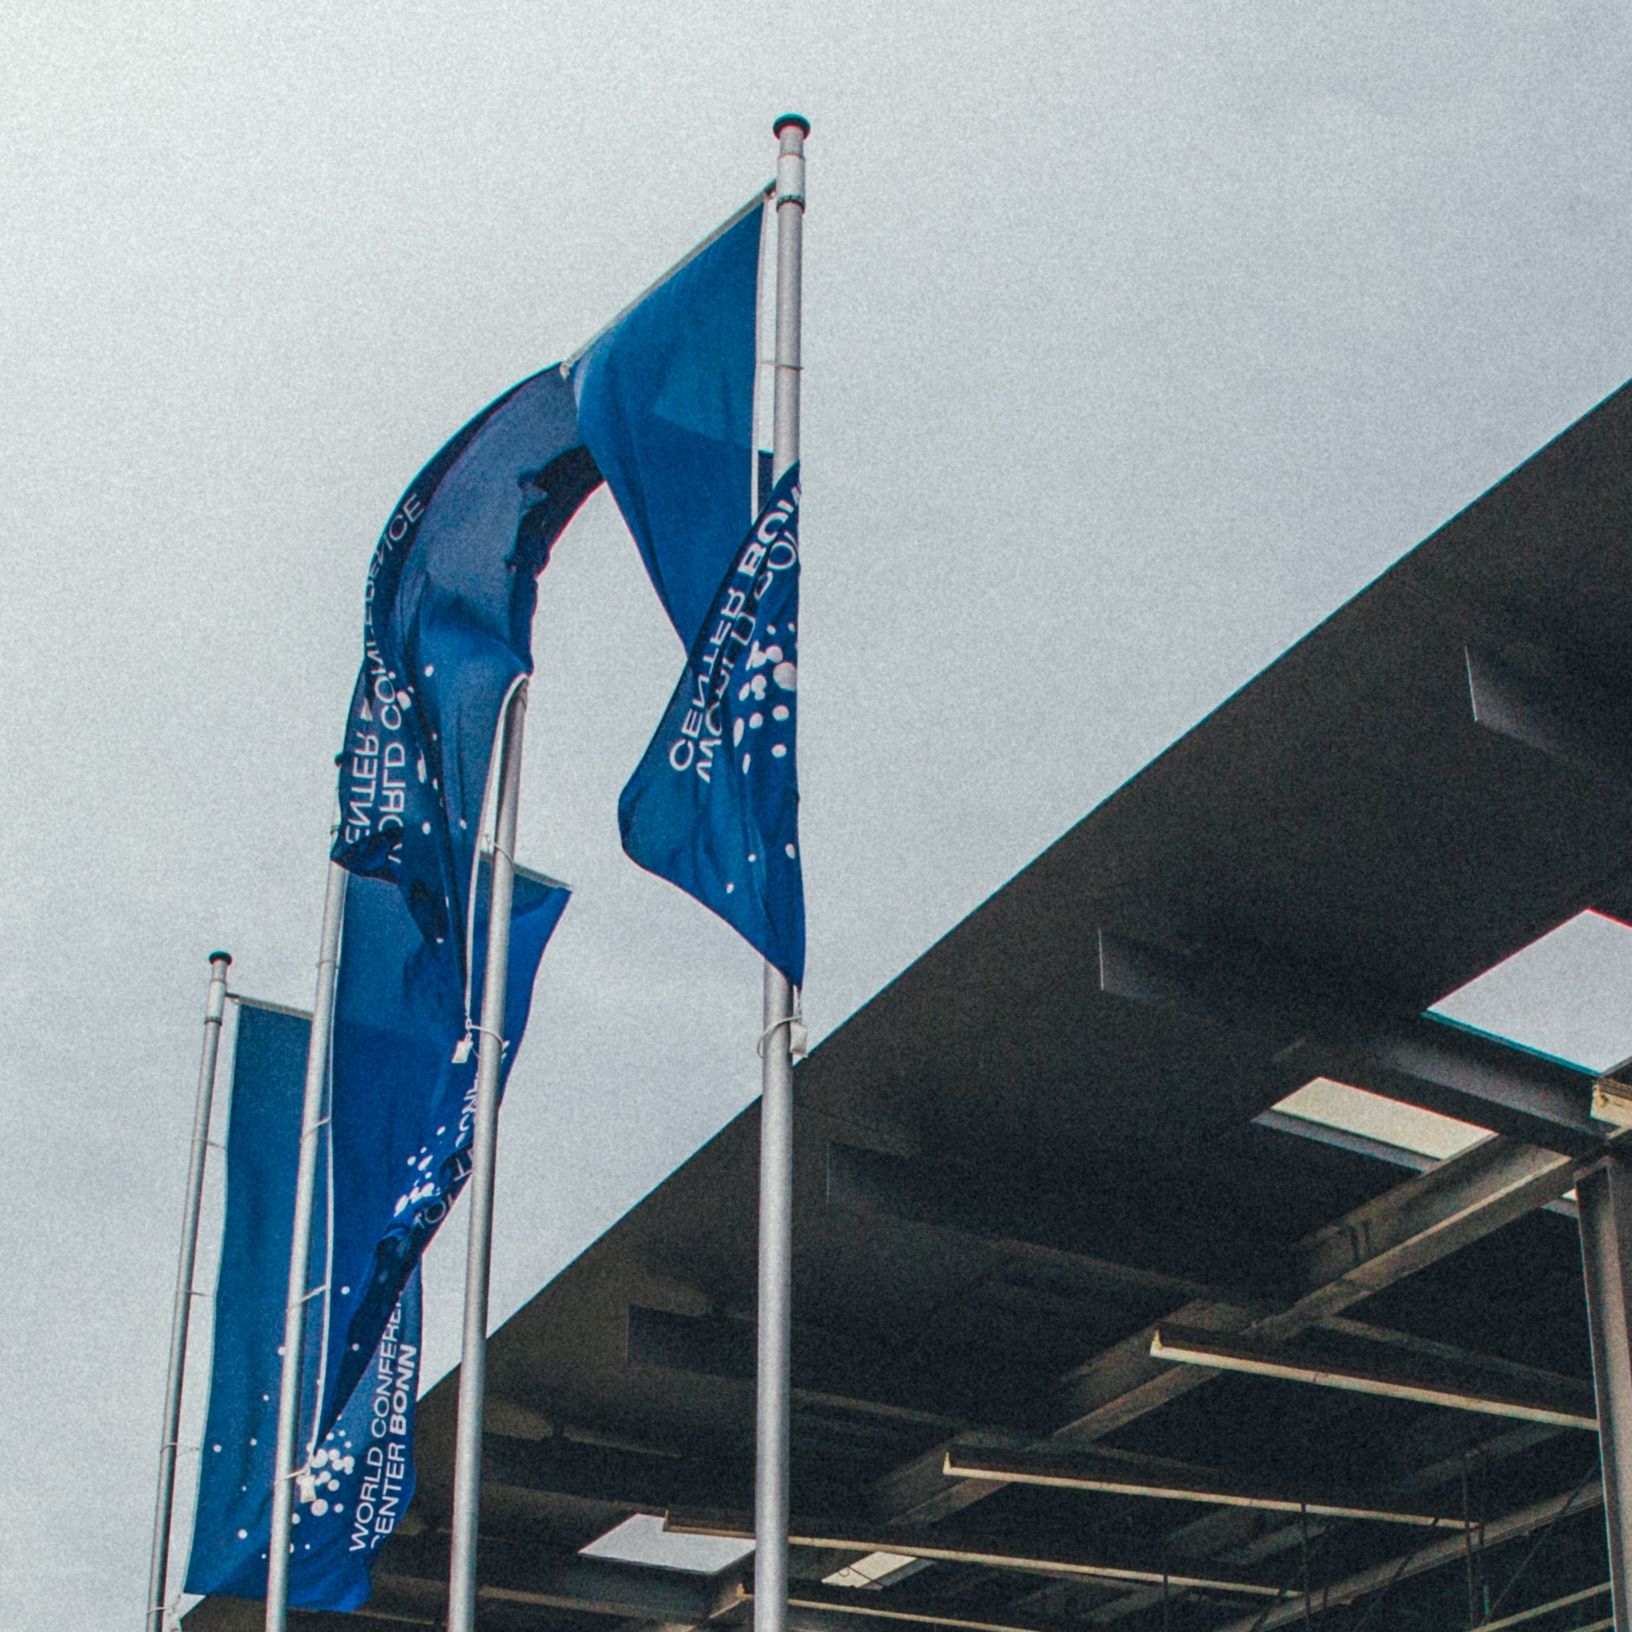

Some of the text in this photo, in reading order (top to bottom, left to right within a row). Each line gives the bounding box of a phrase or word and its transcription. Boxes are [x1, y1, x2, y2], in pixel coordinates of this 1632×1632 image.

[348, 1302, 403, 1552] WORLD CONFERE
[389, 1343, 418, 1436] BONN
